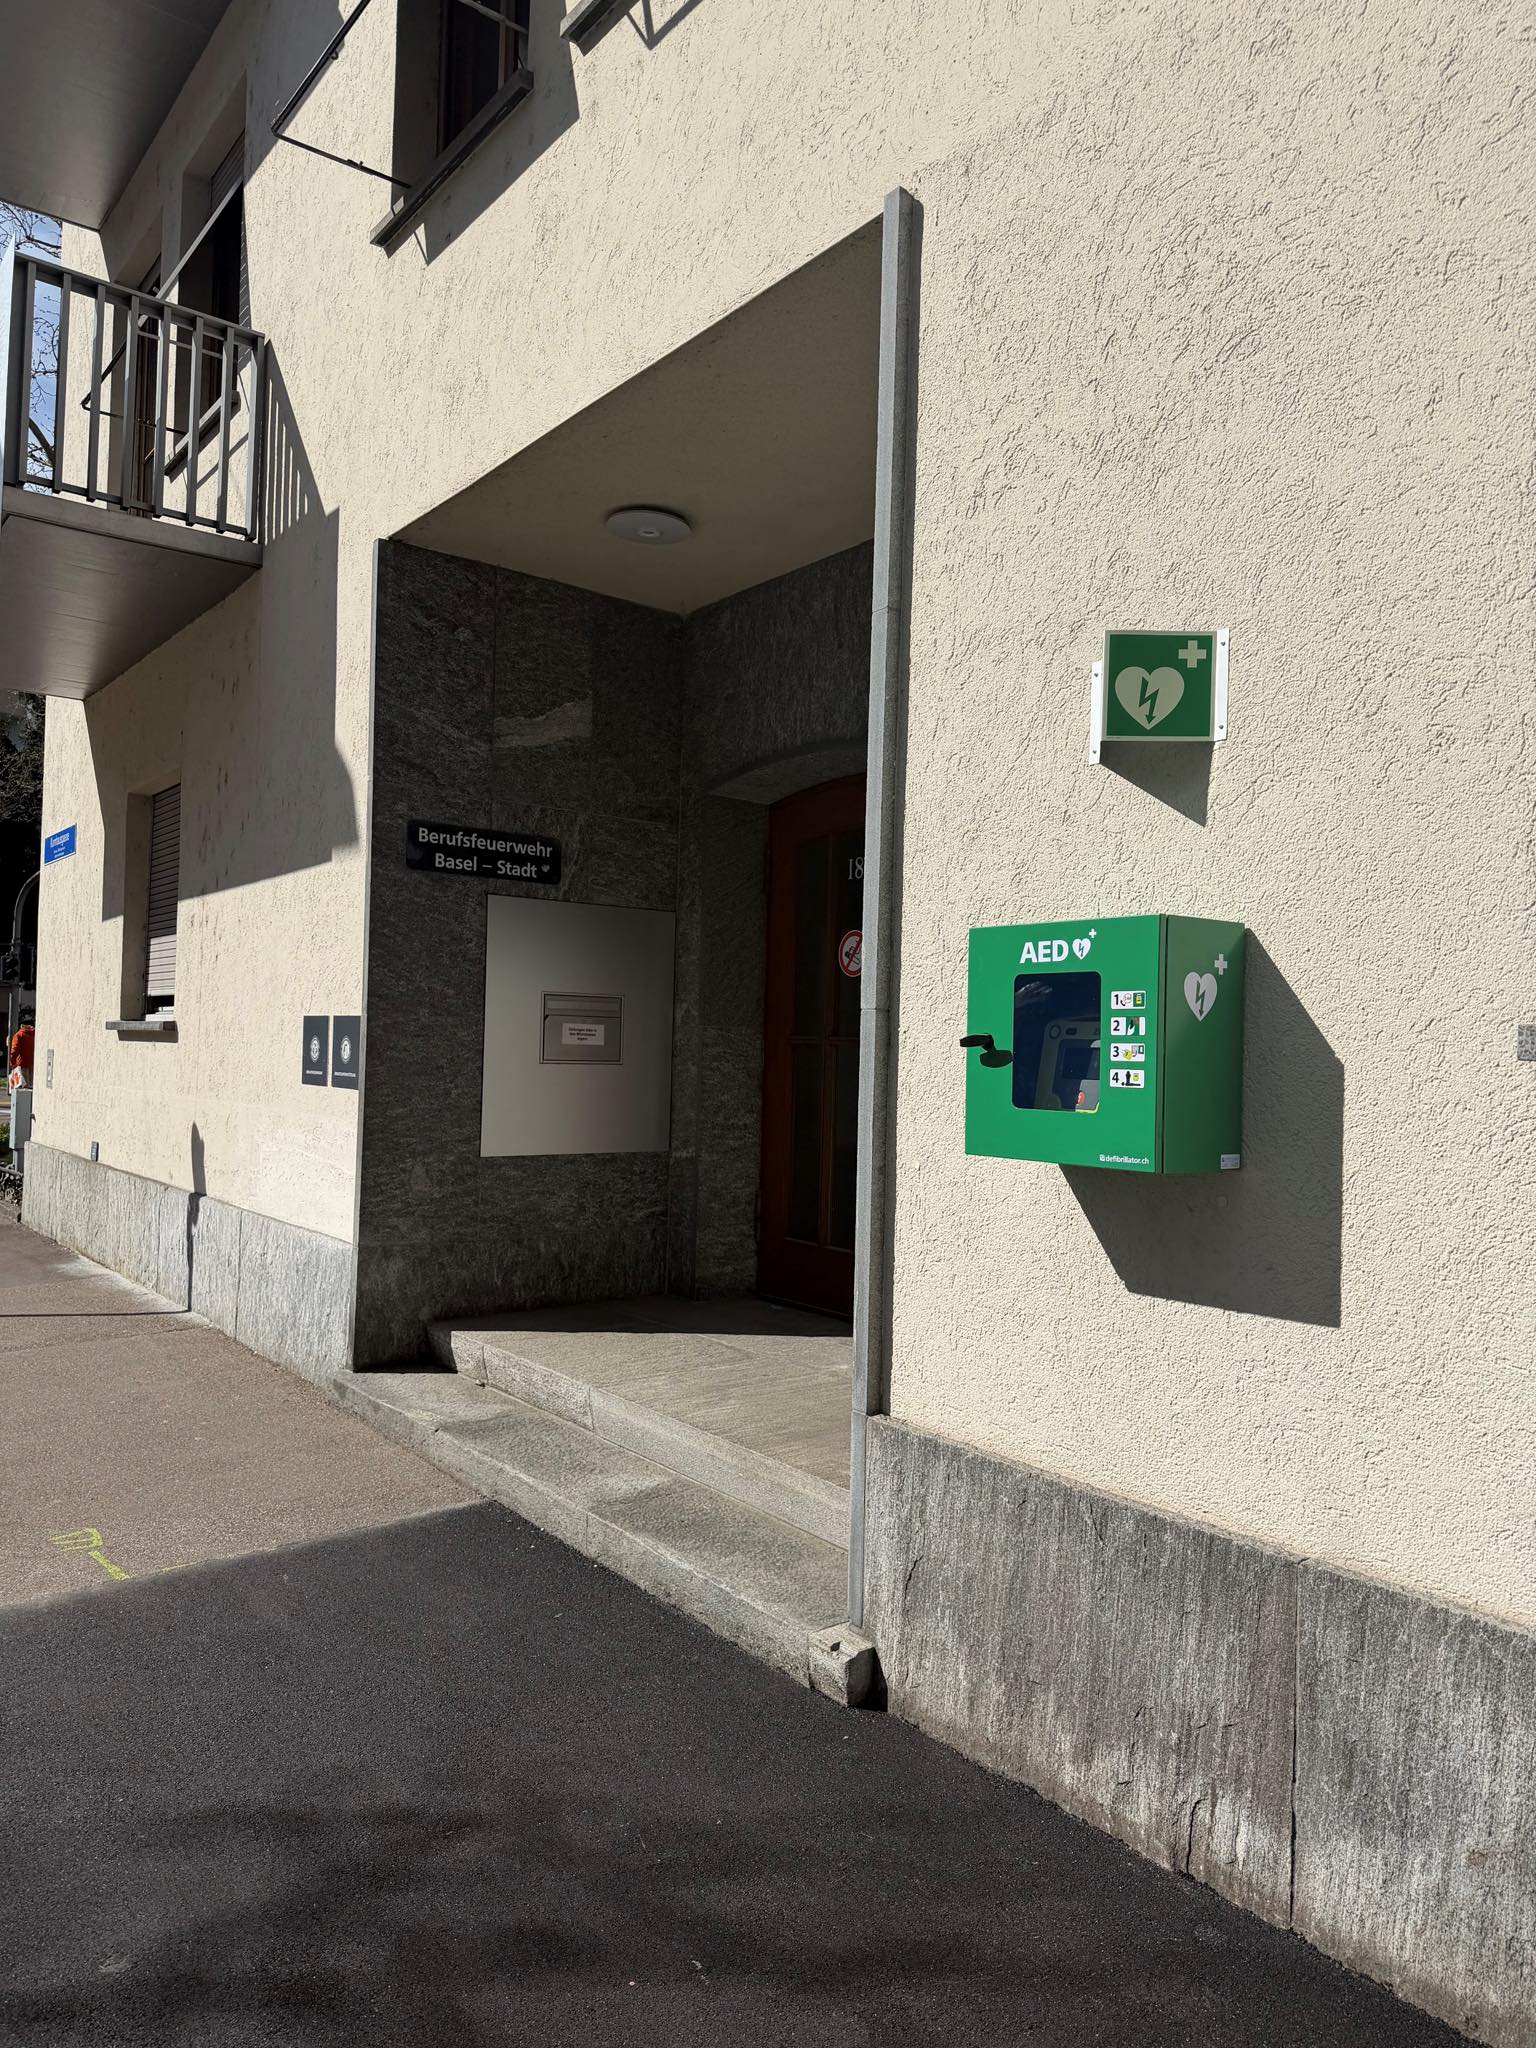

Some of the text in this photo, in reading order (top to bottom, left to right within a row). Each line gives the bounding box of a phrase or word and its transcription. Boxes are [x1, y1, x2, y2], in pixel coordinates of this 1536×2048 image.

[418, 827, 553, 858] Berufsfeuerwehr
[435, 852, 477, 871] Basel
[497, 860, 537, 878] Stadt
[848, 856, 864, 880] 18
[1019, 939, 1069, 964] AED
[1113, 994, 1119, 1006] 1
[1113, 1020, 1120, 1032] 2
[1113, 1046, 1119, 1058] 3
[1112, 1072, 1119, 1083] 4
[1105, 1155, 1150, 1165] defibrillator.ch
